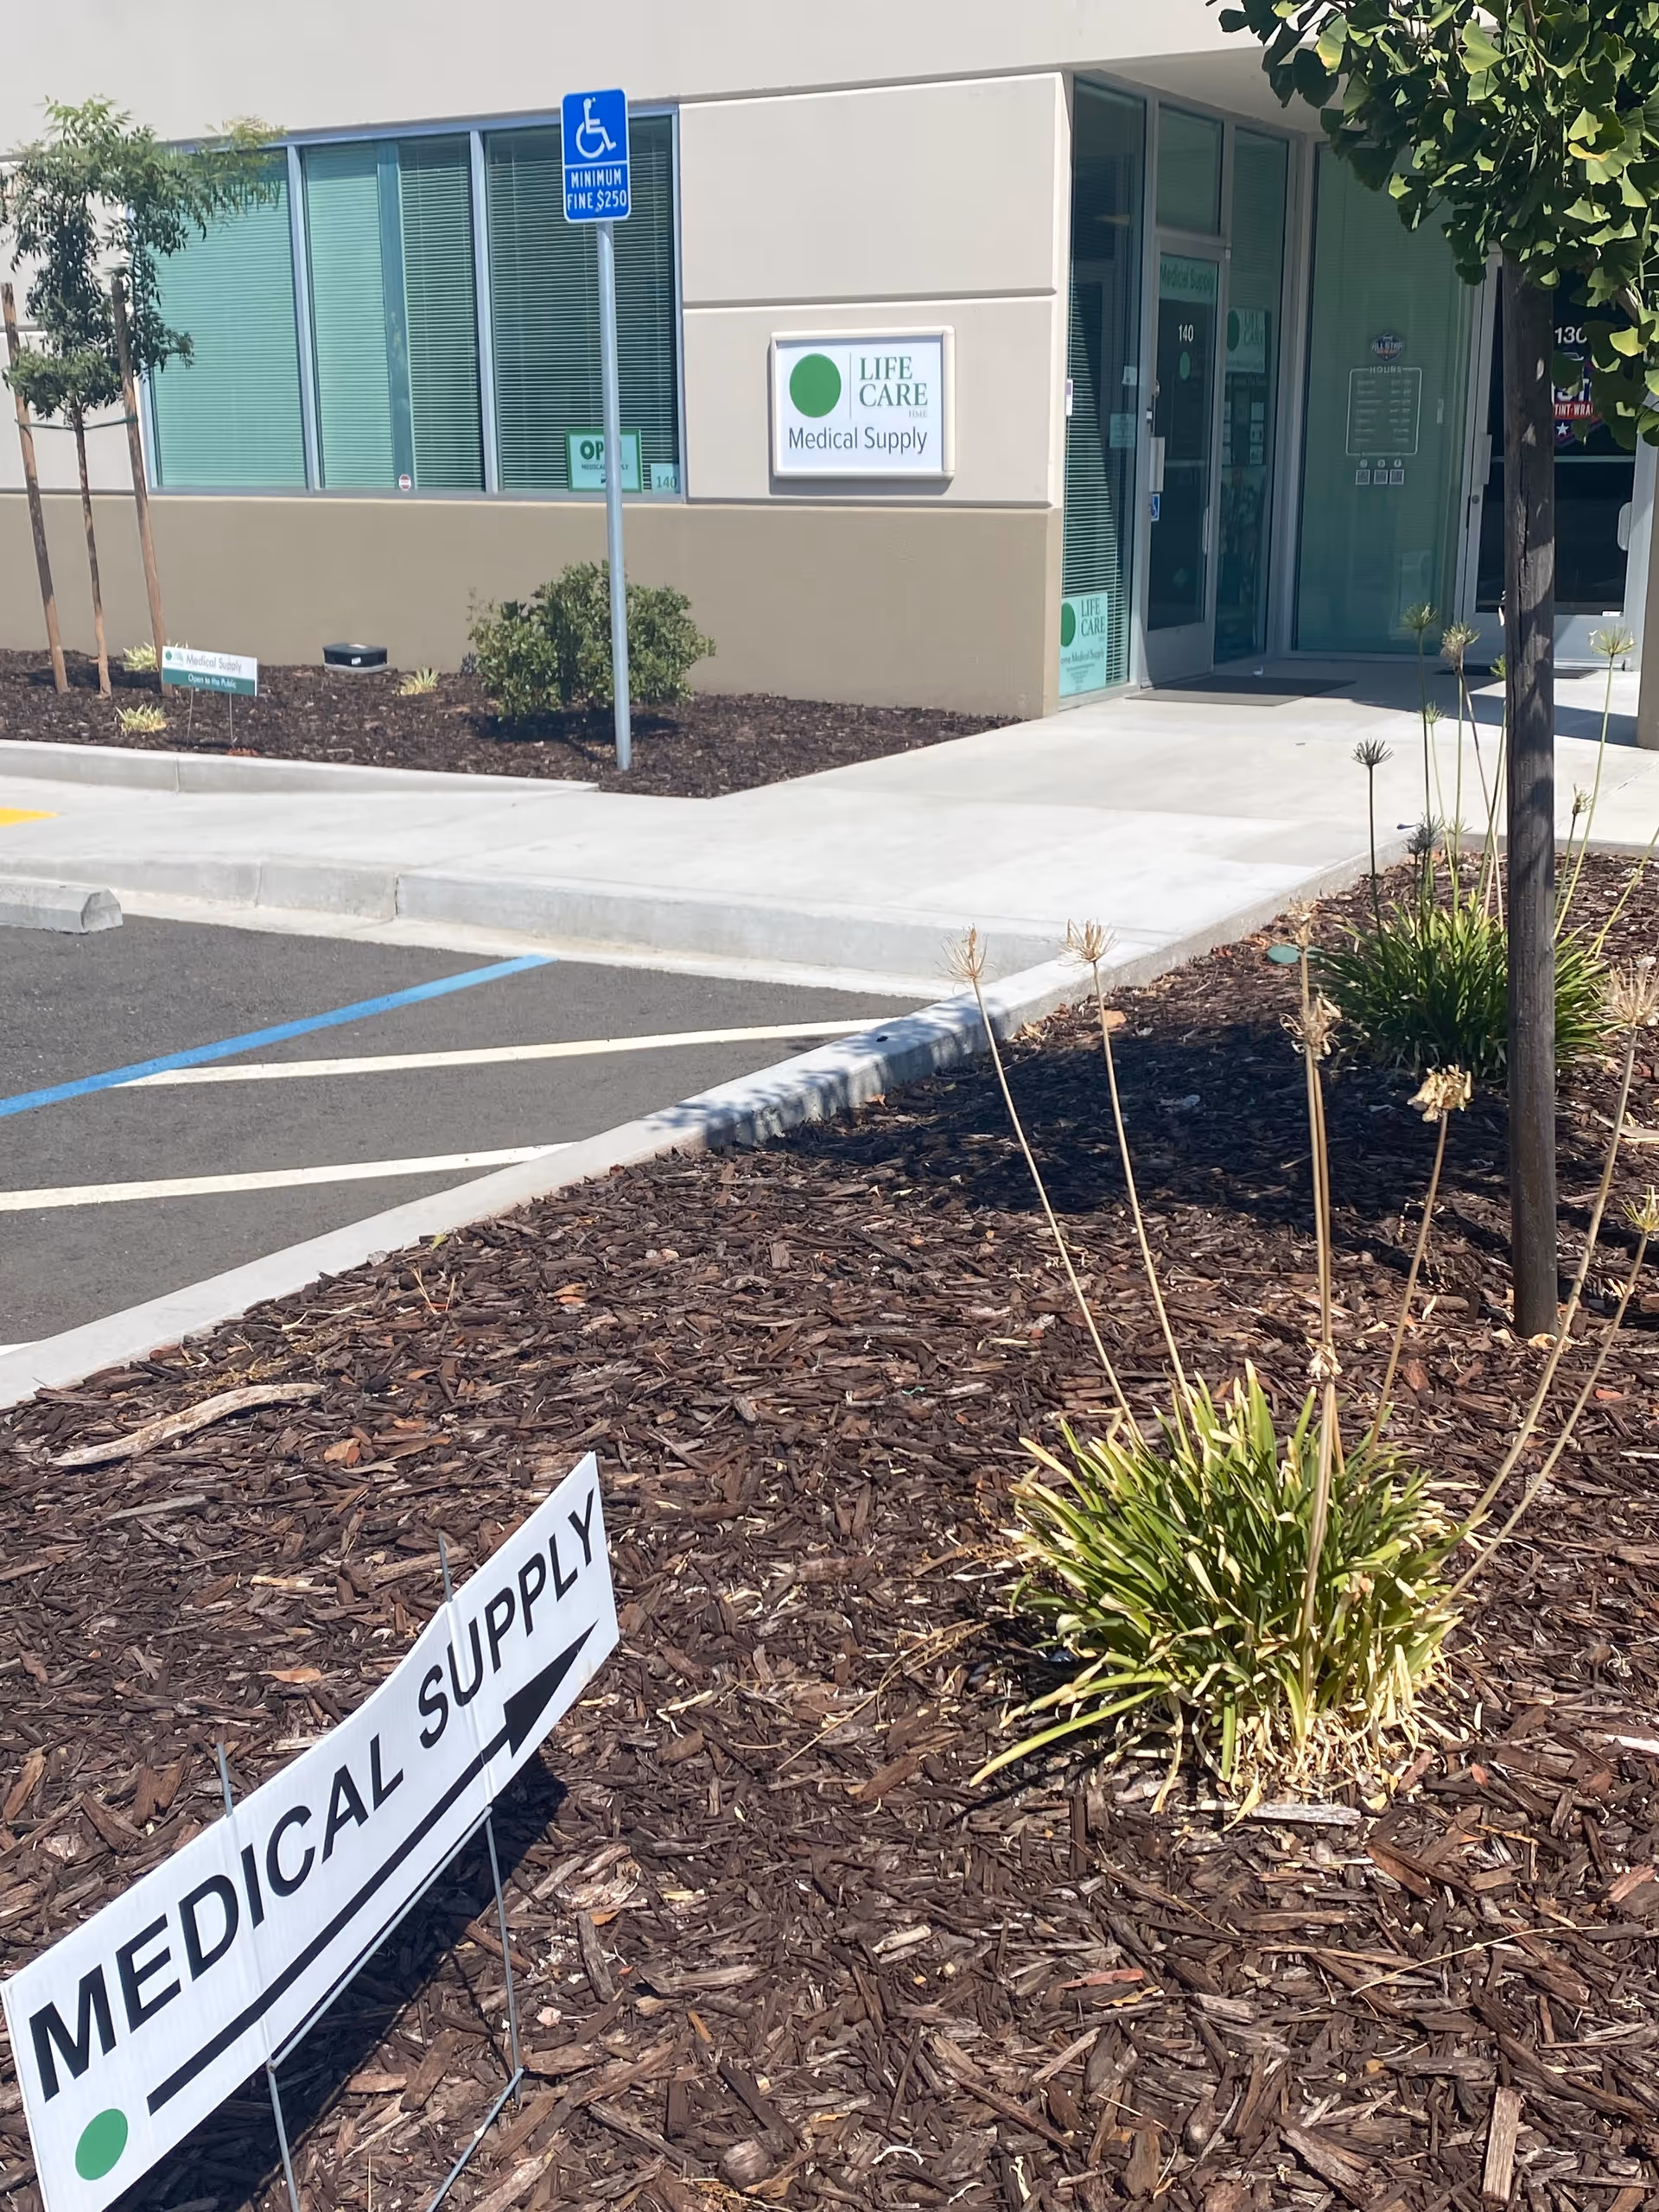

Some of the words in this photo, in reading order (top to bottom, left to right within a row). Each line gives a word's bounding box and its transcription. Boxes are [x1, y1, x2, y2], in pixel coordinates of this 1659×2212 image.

[571, 168, 621, 188] MINIMUM
[567, 192, 594, 211] FINE
[596, 188, 627, 210] $250
[1179, 324, 1194, 342] 140
[859, 356, 912, 380] LIFE
[859, 383, 928, 407] CARE
[789, 427, 858, 449] Medical
[864, 426, 927, 454] Supply
[657, 475, 677, 488] 140
[1081, 598, 1101, 617] LIFE
[1081, 615, 1106, 637] CARE
[186, 654, 217, 668] Medical
[219, 658, 242, 674] Supply
[188, 673, 204, 684] Open
[211, 677, 220, 685] the
[221, 678, 237, 689] Public
[29, 1732, 404, 2102] MEDICAL
[418, 1487, 595, 1750] SUPPLY
